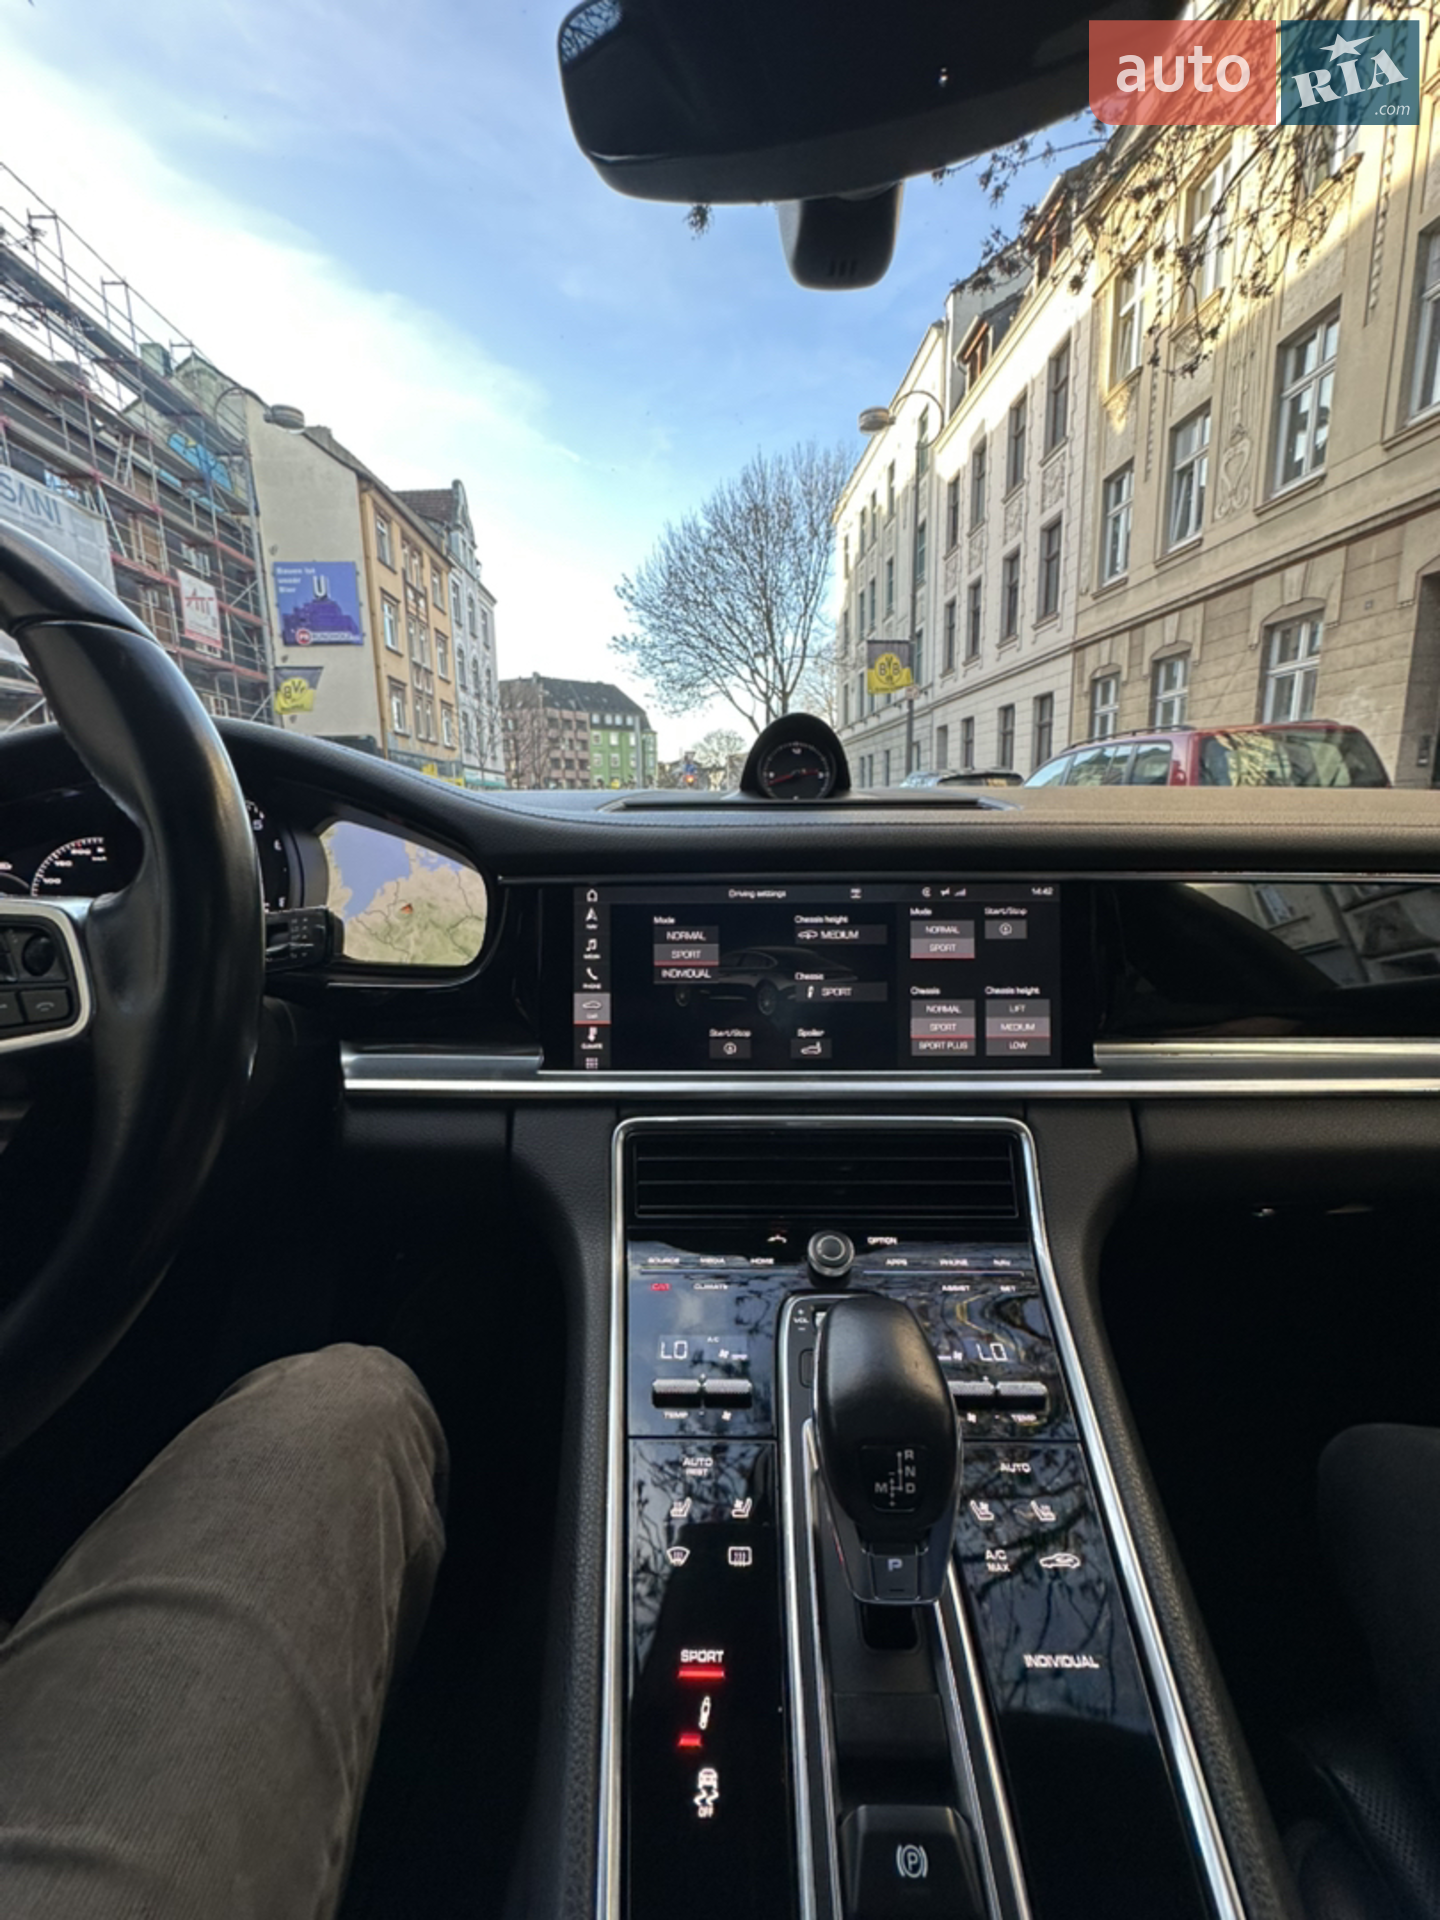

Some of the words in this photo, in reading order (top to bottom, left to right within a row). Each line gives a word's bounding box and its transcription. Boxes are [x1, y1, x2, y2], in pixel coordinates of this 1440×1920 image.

[728, 888, 755, 899] Driving
[756, 888, 787, 899] settings
[910, 907, 932, 916] Mode
[984, 906, 1028, 917] Start/Stop
[653, 915, 676, 925] Mode
[794, 914, 824, 924] Chassis
[824, 914, 849, 926] height
[820, 930, 860, 940] MEDIUM
[925, 925, 960, 935] NORMAL
[666, 931, 706, 942] NORMAL
[929, 943, 957, 953] SPORT
[671, 949, 702, 960] SPORT
[661, 968, 712, 979] INDIVIDUAL
[794, 971, 825, 982] Chassis
[821, 987, 853, 997] SPORT
[909, 986, 941, 996] Chassis
[984, 985, 1015, 996] Chassis
[1015, 985, 1041, 997] height
[925, 1004, 962, 1014] NORMAL
[1008, 1004, 1026, 1014] LIFT
[929, 1022, 957, 1032] SPORT
[1000, 1022, 1036, 1032] MEDIUM
[709, 1028, 752, 1039] Start/Stop
[797, 1027, 825, 1039] Spoiler
[918, 1041, 945, 1051] SPORT
[946, 1041, 969, 1051] PLUS
[1008, 1041, 1028, 1051] LOW
[866, 1236, 898, 1245] OPTION
[699, 1257, 725, 1265] MEDIA
[750, 1257, 775, 1265] HOME
[793, 1316, 809, 1324] VOL
[660, 1339, 688, 1360] LO
[976, 1342, 1008, 1361] LO
[663, 1411, 689, 1419] TEMP
[1010, 1413, 1037, 1422] TEMP
[904, 1450, 915, 1461] R
[682, 1457, 713, 1468] AUTO
[1000, 1462, 1032, 1473] AUTO
[904, 1466, 916, 1478] N
[874, 1482, 888, 1494] M
[905, 1483, 916, 1495] D
[985, 1549, 1008, 1561] A/C
[888, 1558, 903, 1572] P
[986, 1562, 1011, 1573] MAX
[680, 1649, 725, 1663] SPORT
[1023, 1653, 1101, 1670] INDIVIDUAL
